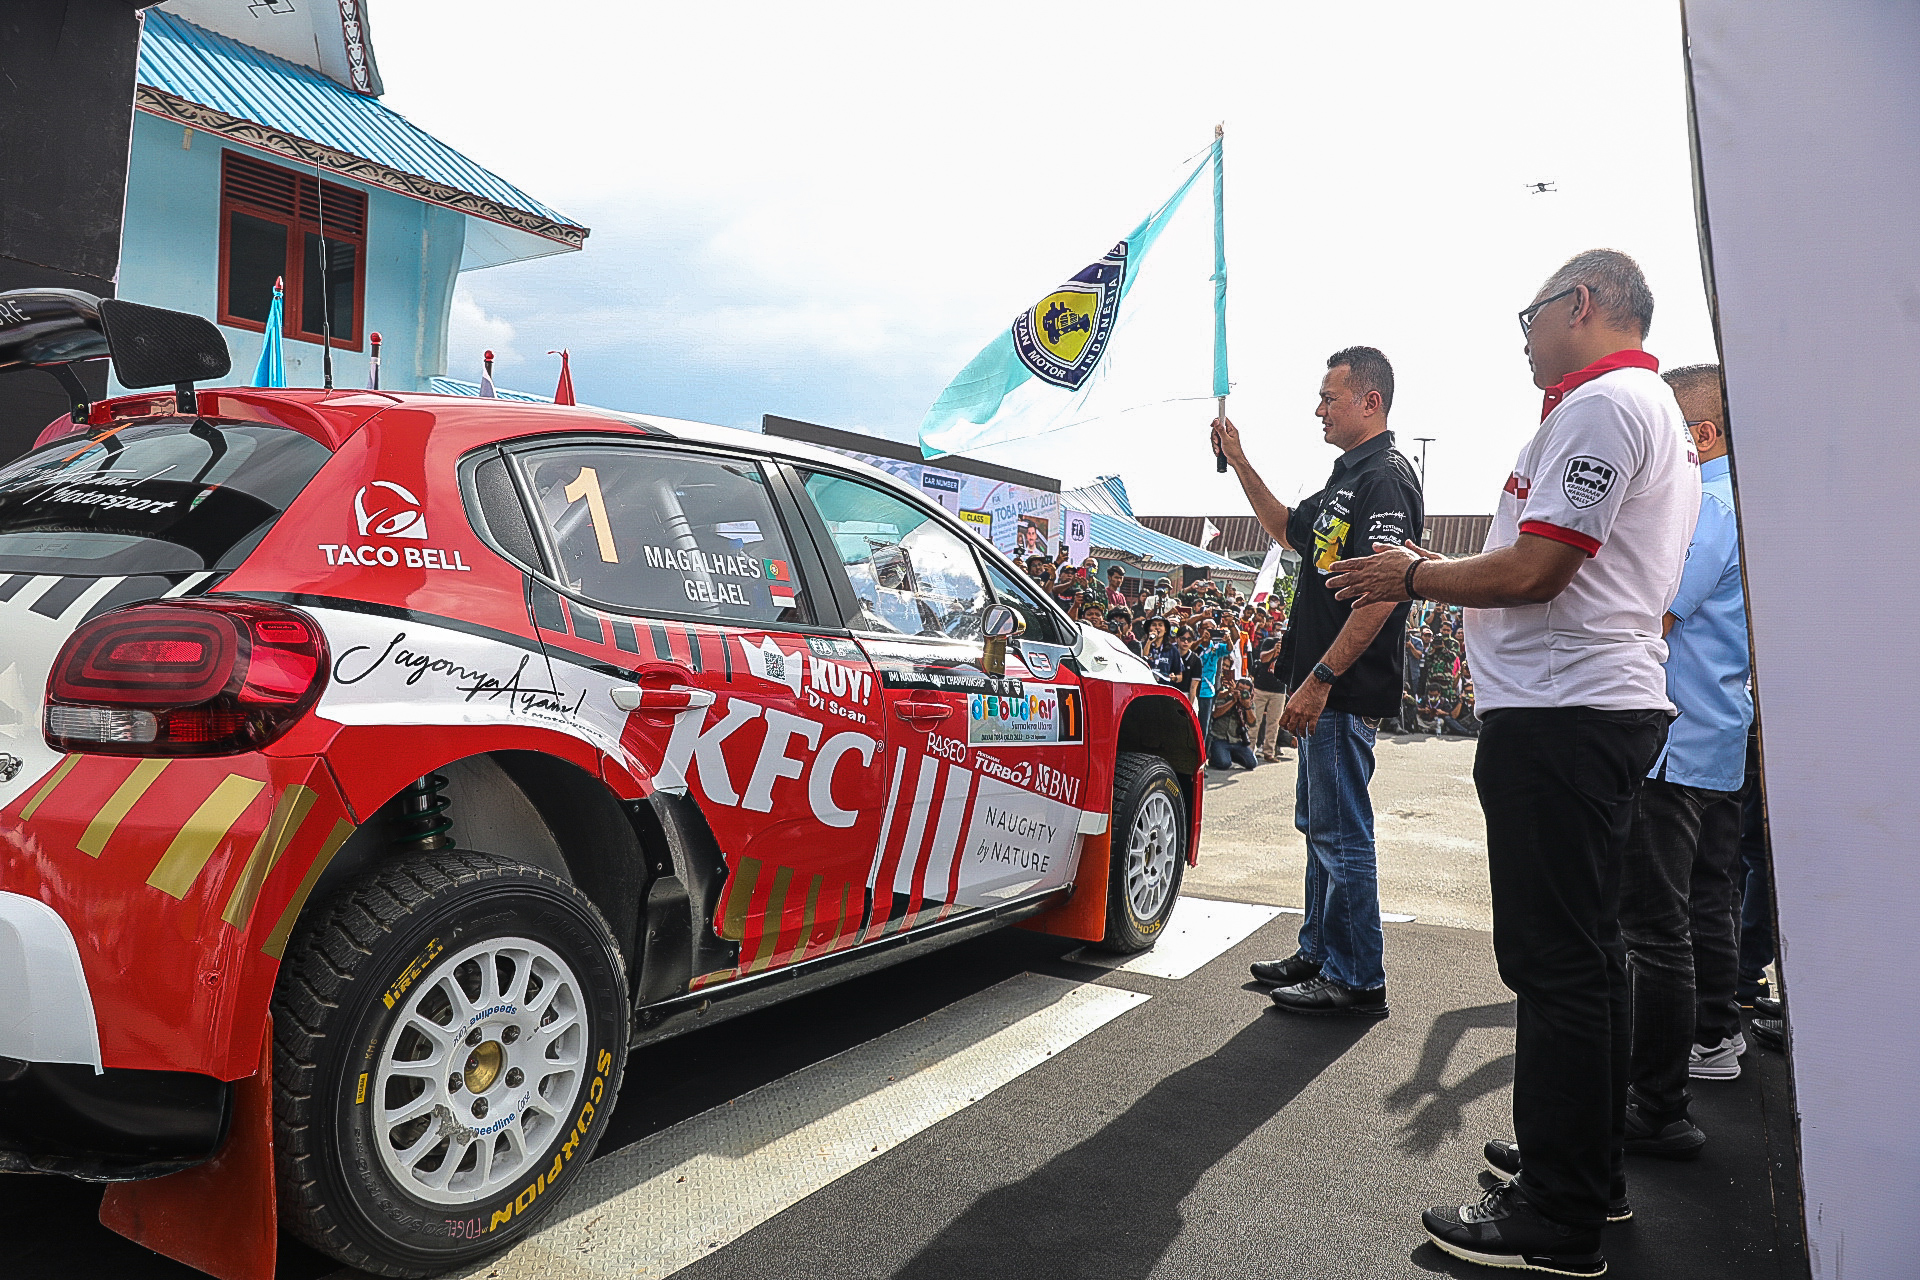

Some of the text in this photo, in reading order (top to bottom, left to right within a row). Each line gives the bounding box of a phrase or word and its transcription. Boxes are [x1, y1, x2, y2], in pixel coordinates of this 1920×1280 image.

[0, 300, 31, 325] RE
[1028, 350, 1066, 379] MOTOR
[1080, 277, 1118, 372] INDONESIA
[924, 476, 958, 490] CAR NUMBER
[44, 489, 178, 514] Motorsport
[564, 466, 620, 563] 1
[995, 503, 1018, 521] TOBA
[1018, 497, 1039, 515] RALLY
[1571, 495, 1590, 505] RALLY
[966, 513, 984, 523] CLASS
[318, 544, 471, 572] TACO BELL
[683, 579, 750, 606] GELAEL
[808, 655, 872, 706] KUY!
[809, 692, 867, 724] Di Scan
[1065, 693, 1075, 736] 1
[926, 732, 967, 763] PASEO
[1048, 769, 1081, 805] BNI
[985, 806, 1057, 844] NAUGHTY
[977, 838, 1051, 873] by NATURE
[470, 1004, 518, 1026] speedline
[489, 1048, 612, 1233] SCORPION
